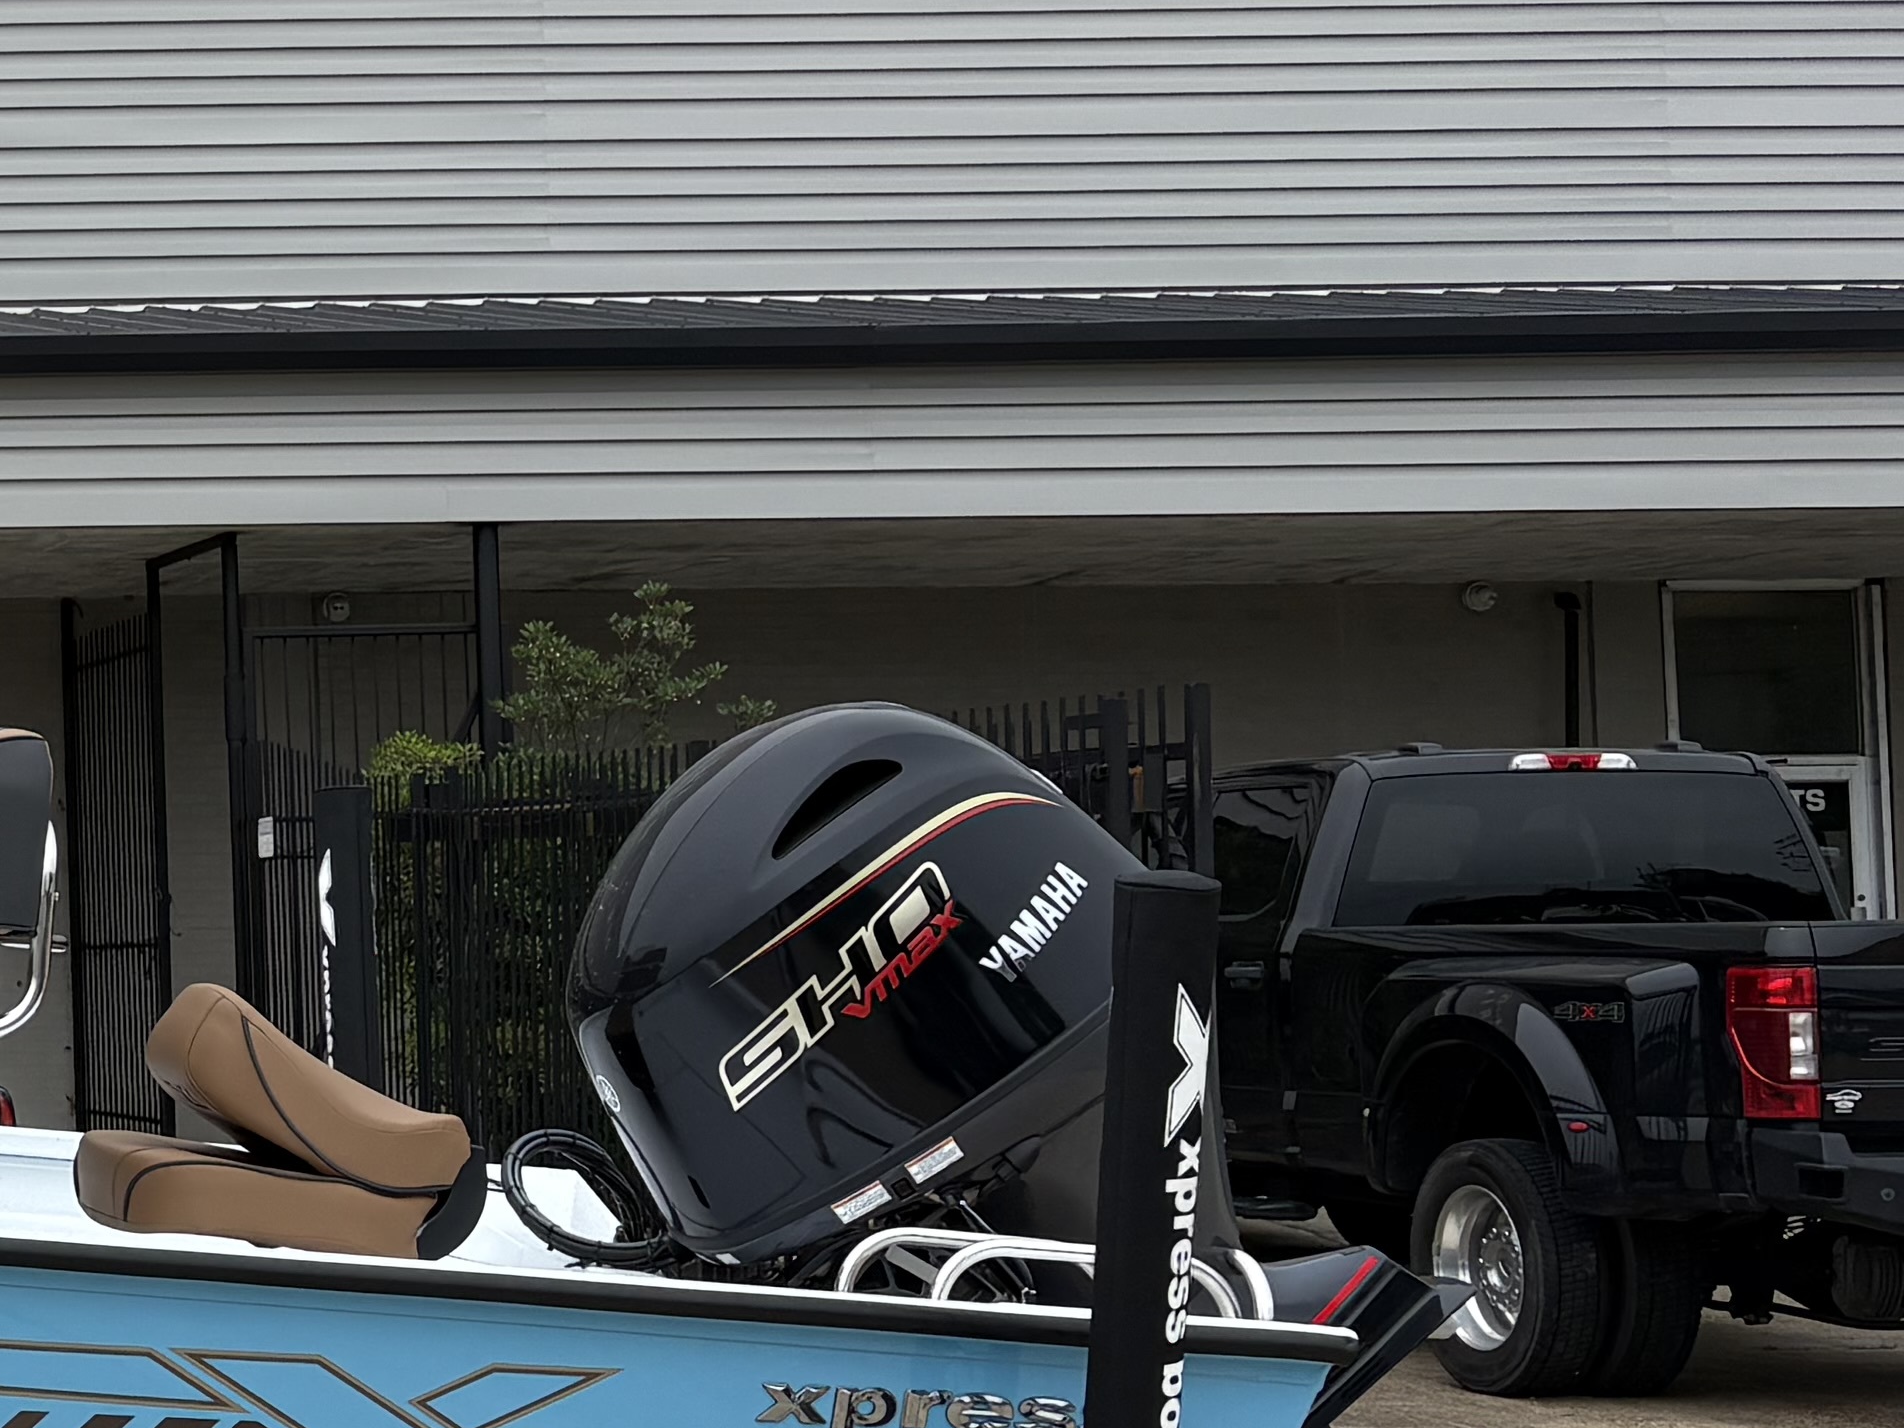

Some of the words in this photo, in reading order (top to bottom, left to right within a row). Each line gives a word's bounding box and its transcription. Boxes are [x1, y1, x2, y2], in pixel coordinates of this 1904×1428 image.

[719, 860, 951, 1112] SHO
[978, 861, 1089, 983] YAMAHA
[1164, 1137, 1200, 1345] xpress
